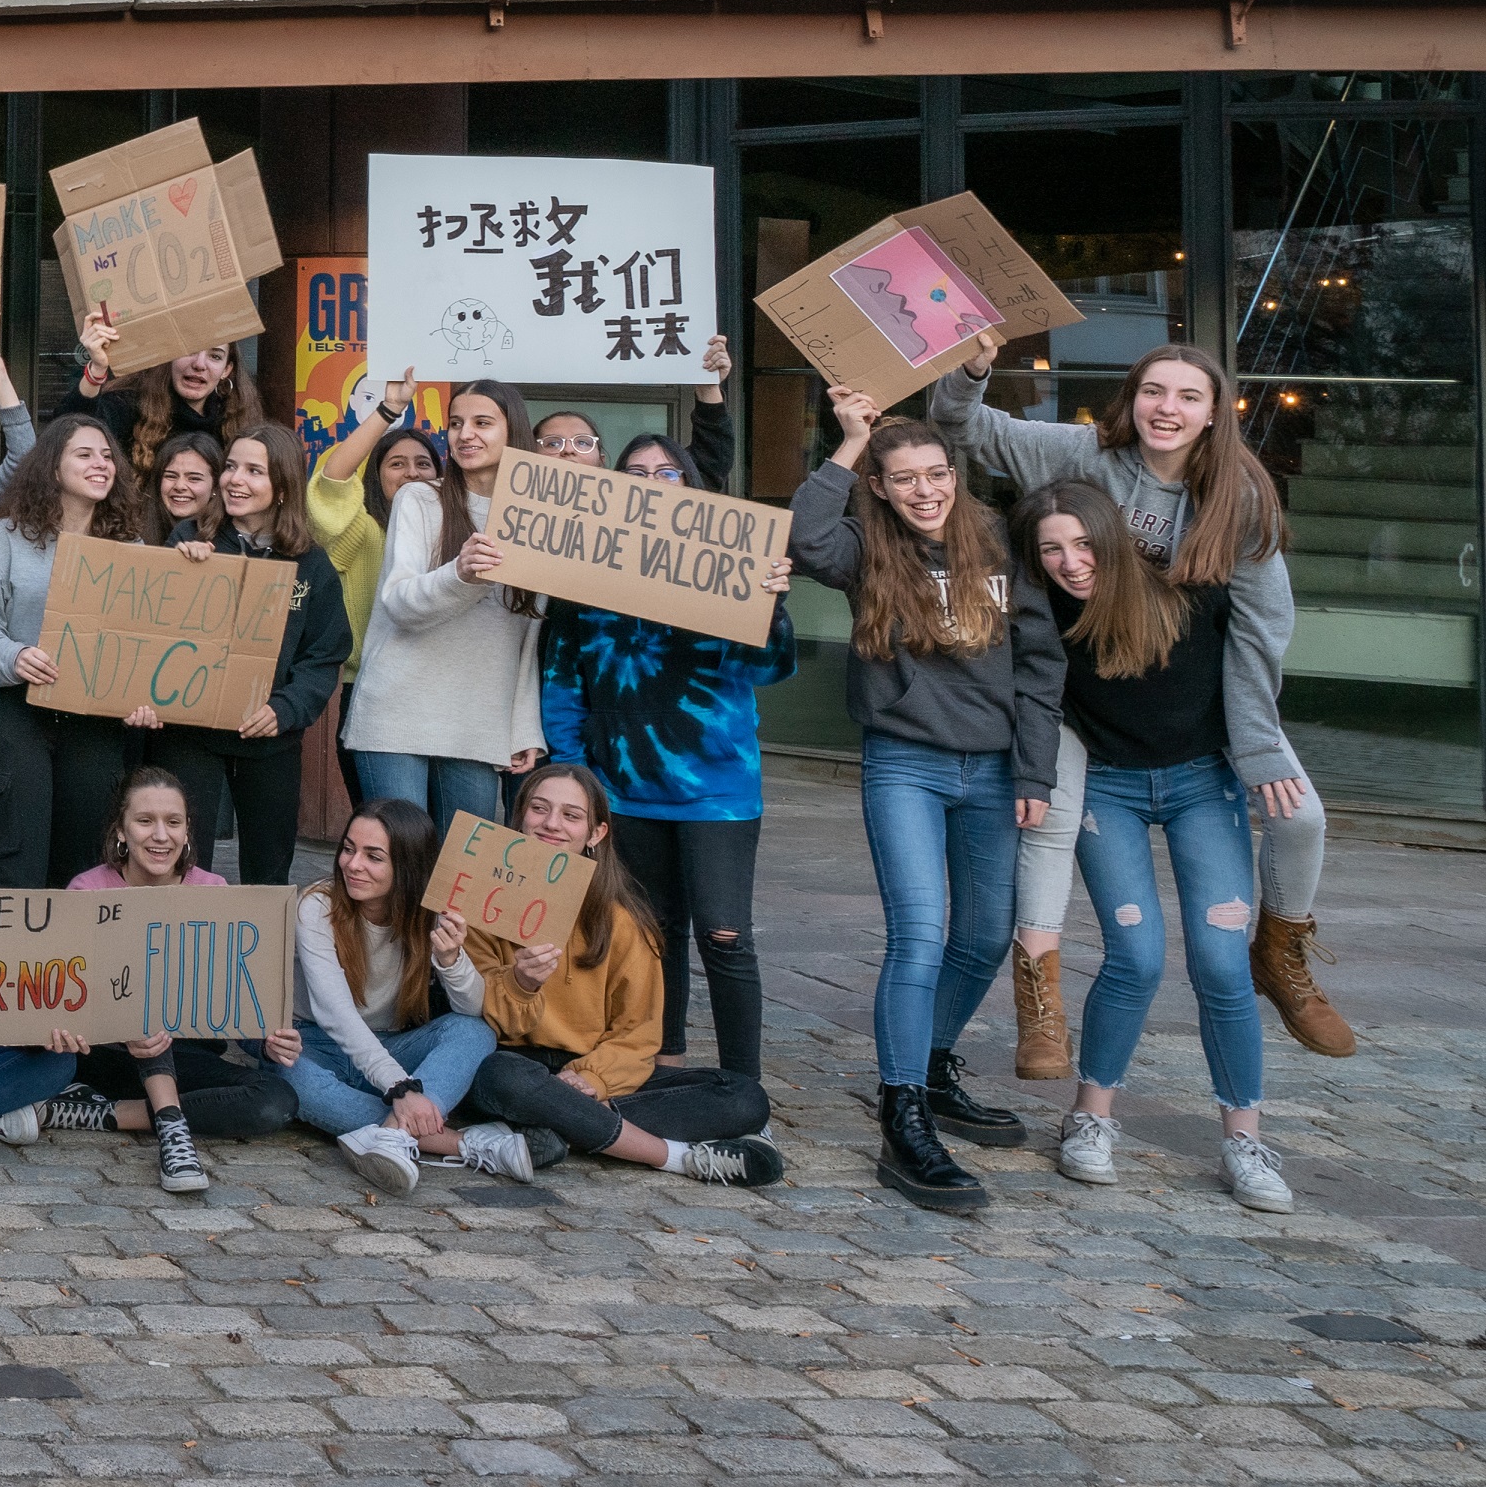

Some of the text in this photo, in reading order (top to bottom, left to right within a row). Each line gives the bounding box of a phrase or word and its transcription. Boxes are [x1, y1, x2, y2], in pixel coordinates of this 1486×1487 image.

[72, 196, 163, 256] MAKE
[416, 196, 589, 255] 拯救
[94, 252, 119, 273] NOT
[529, 248, 685, 317] 我们
[315, 342, 345, 353] ELS
[510, 460, 613, 517] ONADES
[624, 484, 664, 530] DE
[671, 498, 757, 554] CALOR
[496, 504, 756, 602] SEQUÍA DE VALORS
[72, 555, 289, 642] MAKE LOVE
[56, 621, 152, 701] NOT
[462, 820, 570, 885] ECO
[492, 866, 527, 888] NOT
[97, 903, 123, 925] DE
[445, 871, 548, 940] EGO
[109, 963, 134, 1002] el
[142, 921, 266, 1036] FUTUR
